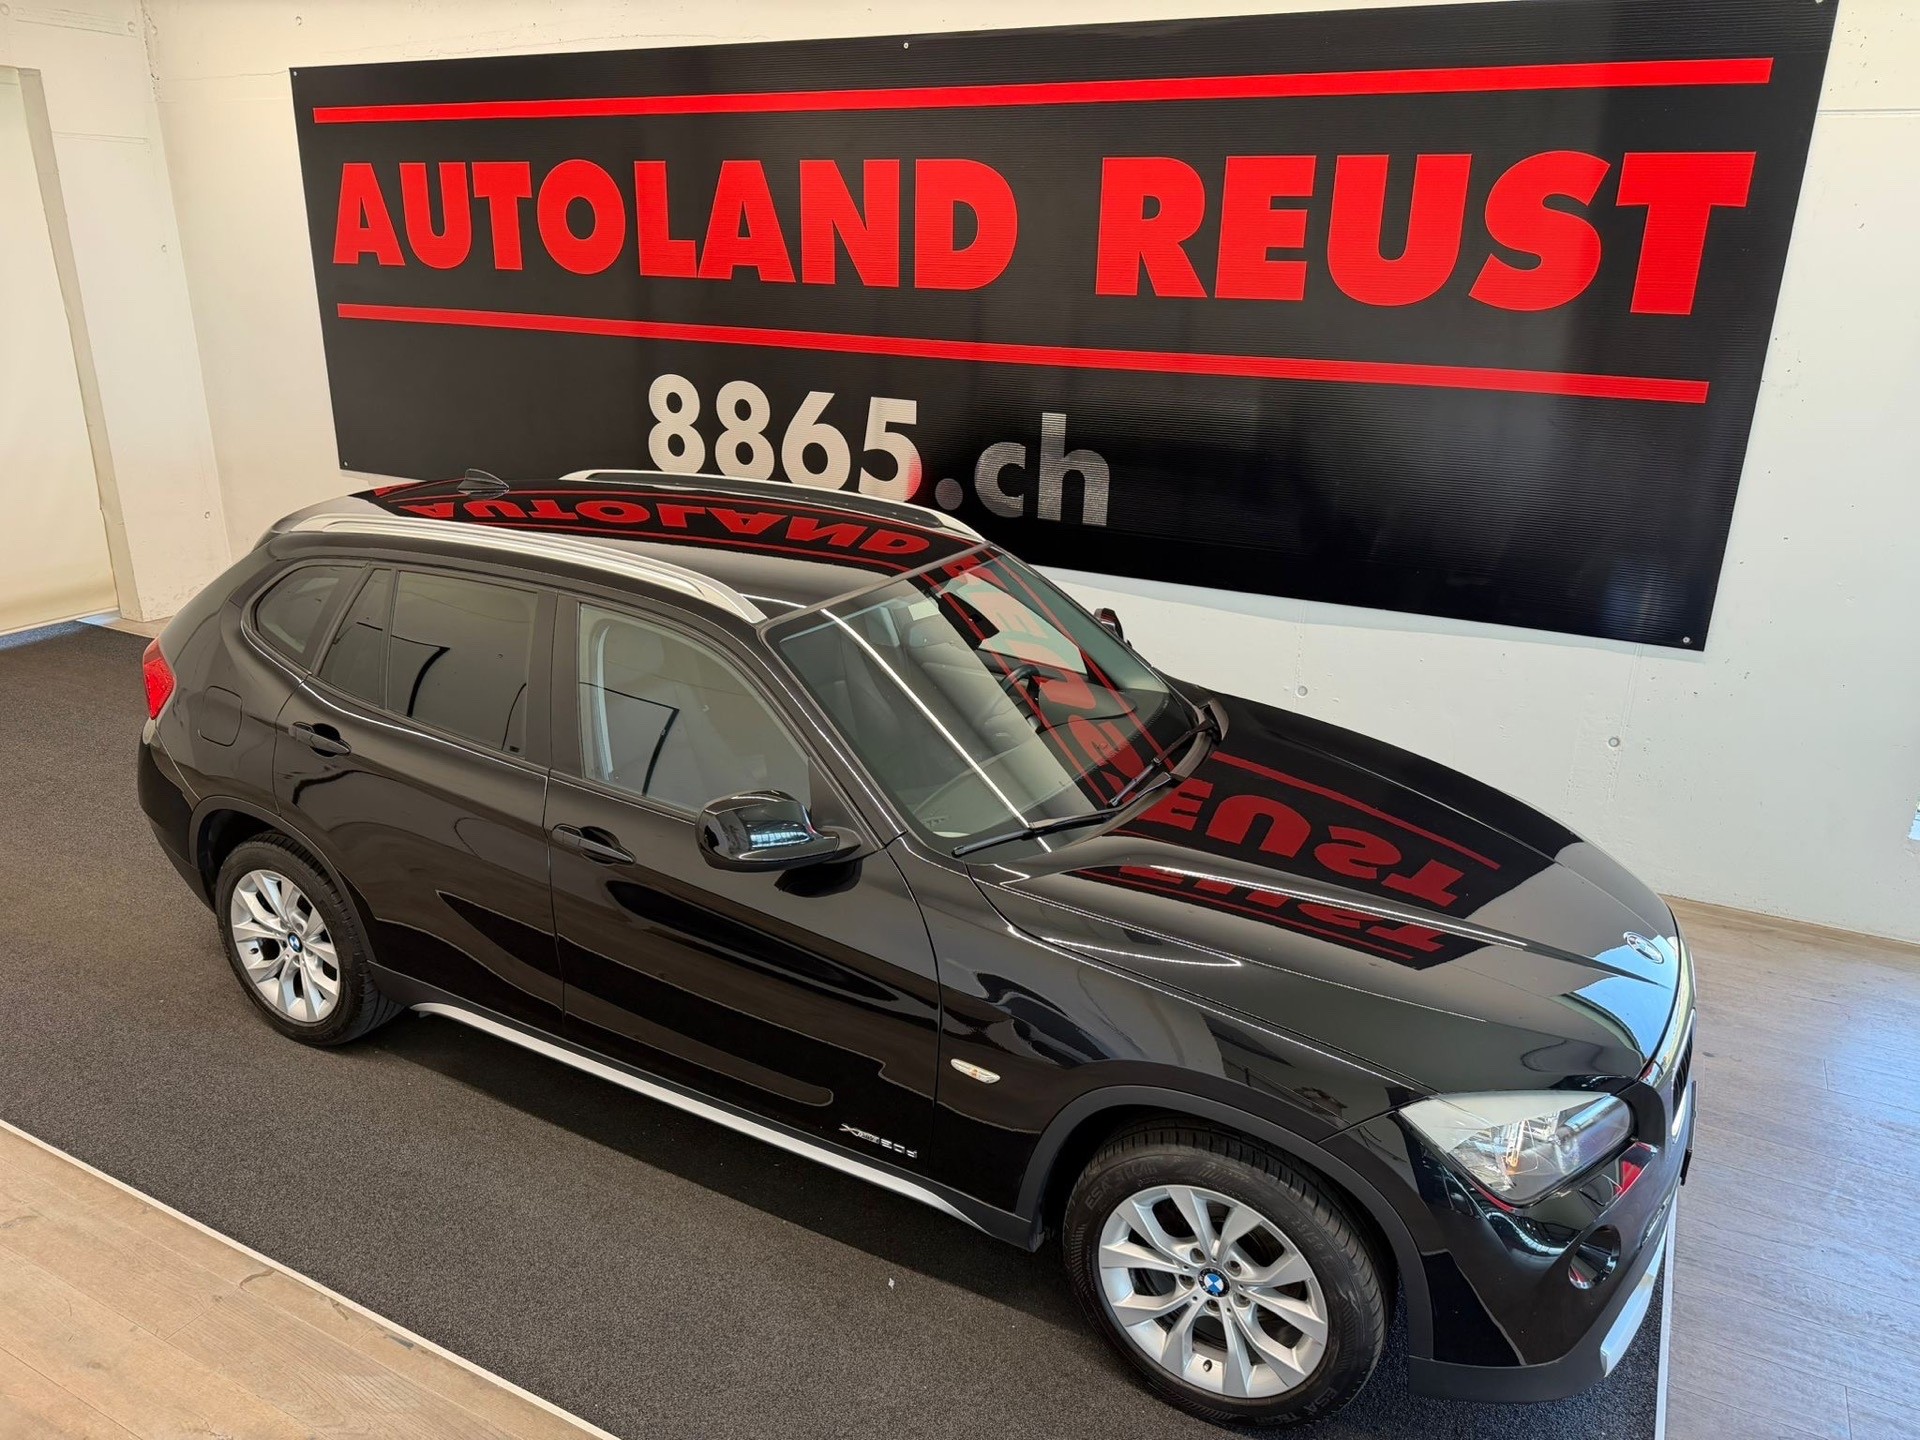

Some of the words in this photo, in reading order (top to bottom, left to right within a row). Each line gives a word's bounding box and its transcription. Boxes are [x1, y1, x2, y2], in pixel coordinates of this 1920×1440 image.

[333, 158, 1019, 292] AUTOLAND
[1094, 149, 1758, 316] REUST
[648, 373, 1111, 527] 8865.ch
